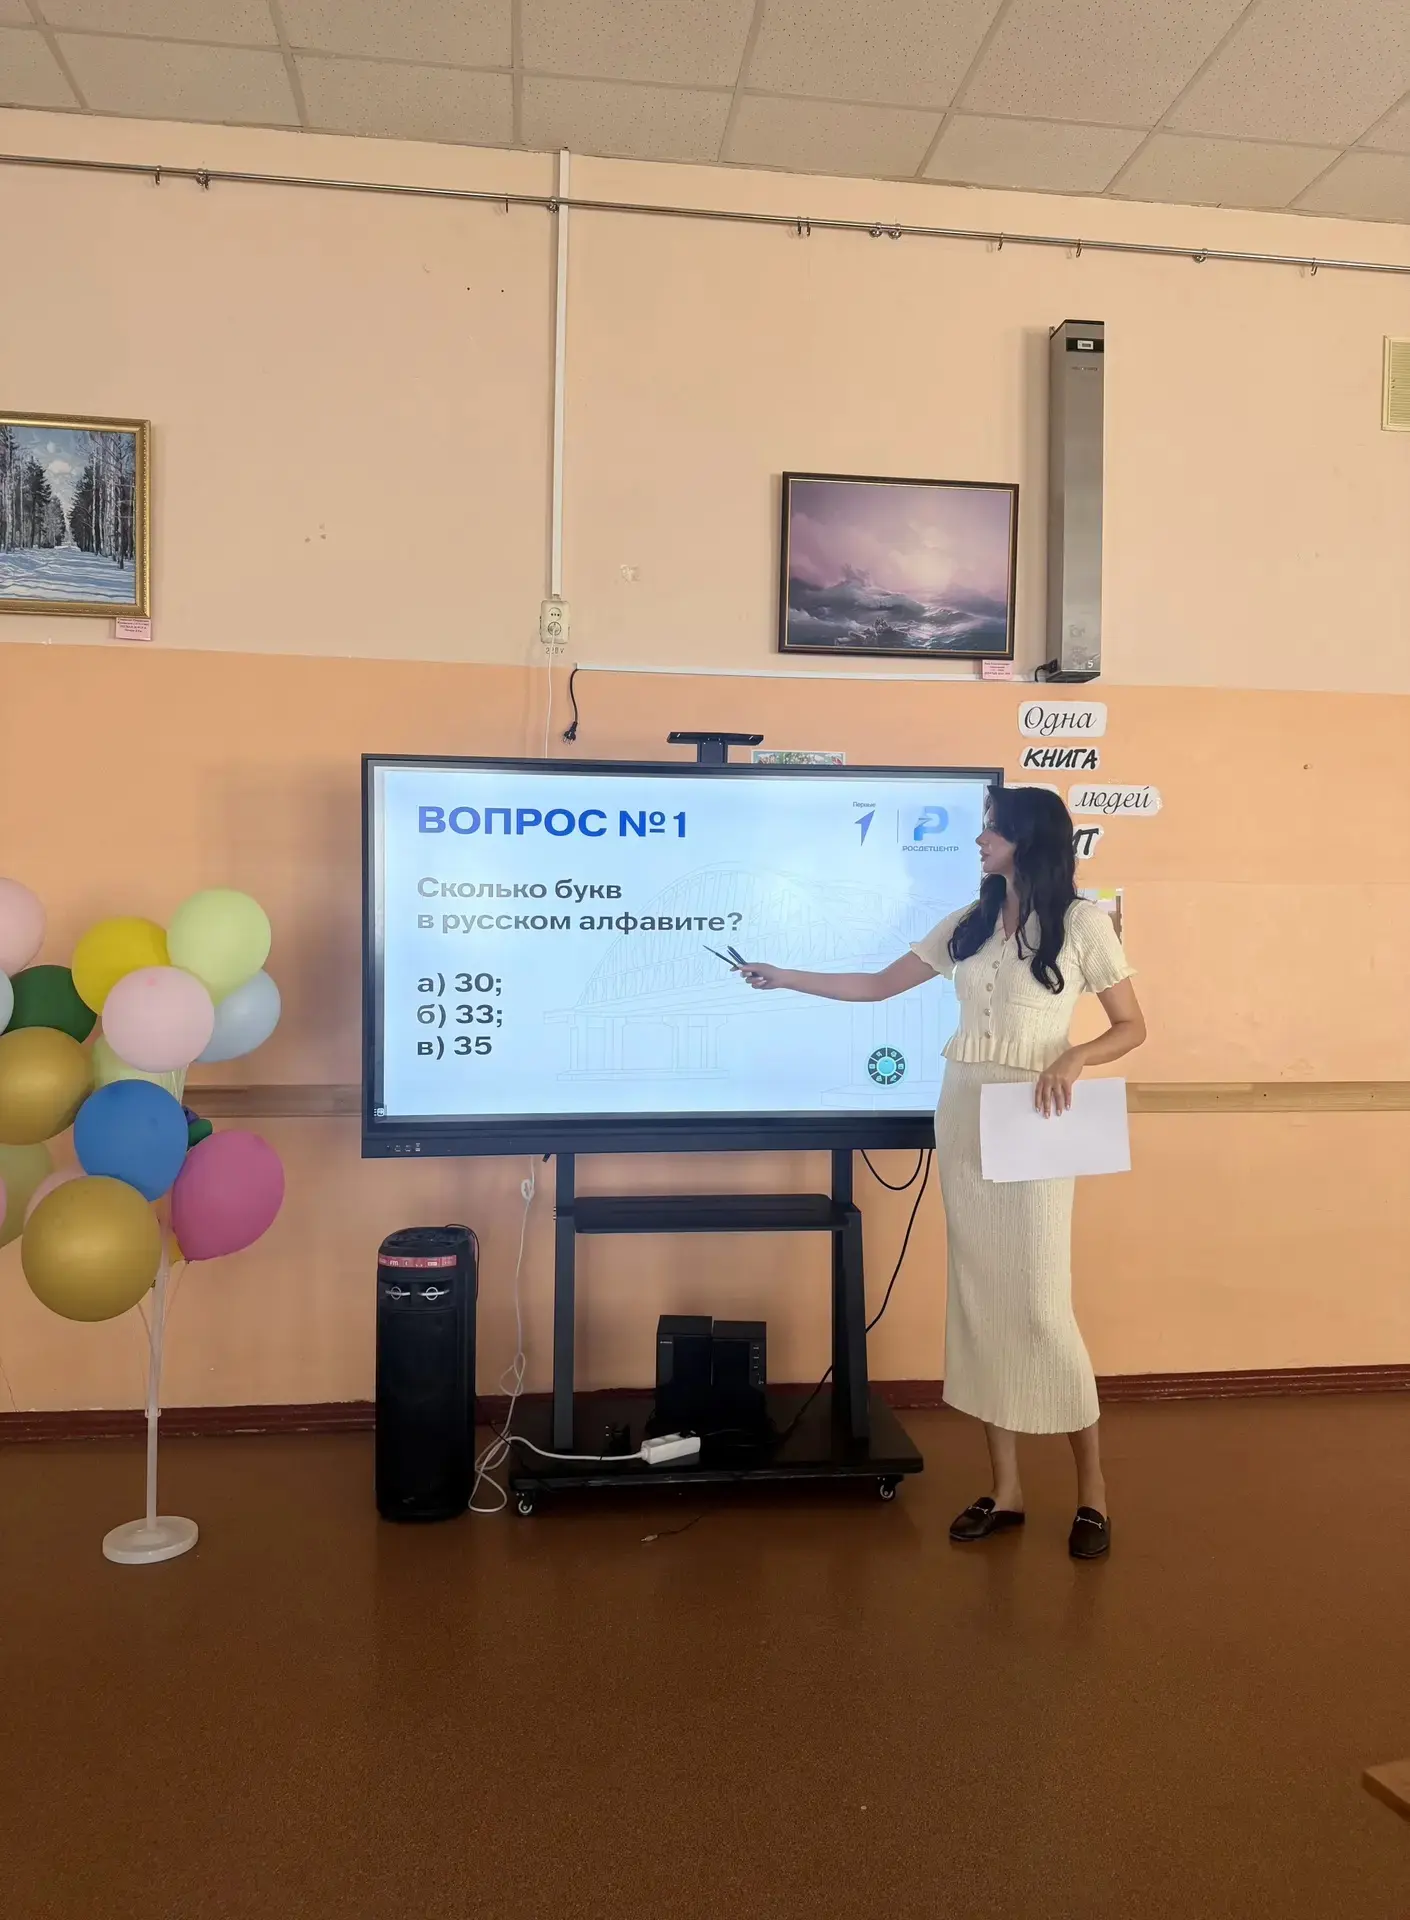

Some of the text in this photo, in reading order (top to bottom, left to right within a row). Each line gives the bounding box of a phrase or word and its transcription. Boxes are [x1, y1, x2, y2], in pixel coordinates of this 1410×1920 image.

[1023, 706, 1097, 737] Одна
[1023, 748, 1098, 770] КНИГА
[1075, 786, 1154, 814] людей
[417, 805, 608, 838] ВОПРОС
[902, 844, 960, 853] РОСДЕТЦЕНТР
[416, 876, 623, 906] Сколько букв
[416, 910, 743, 935] в русском алфавите?
[416, 973, 503, 998] а) 30;
[416, 1003, 504, 1029] б) 33;
[416, 1035, 493, 1060] в) 35
